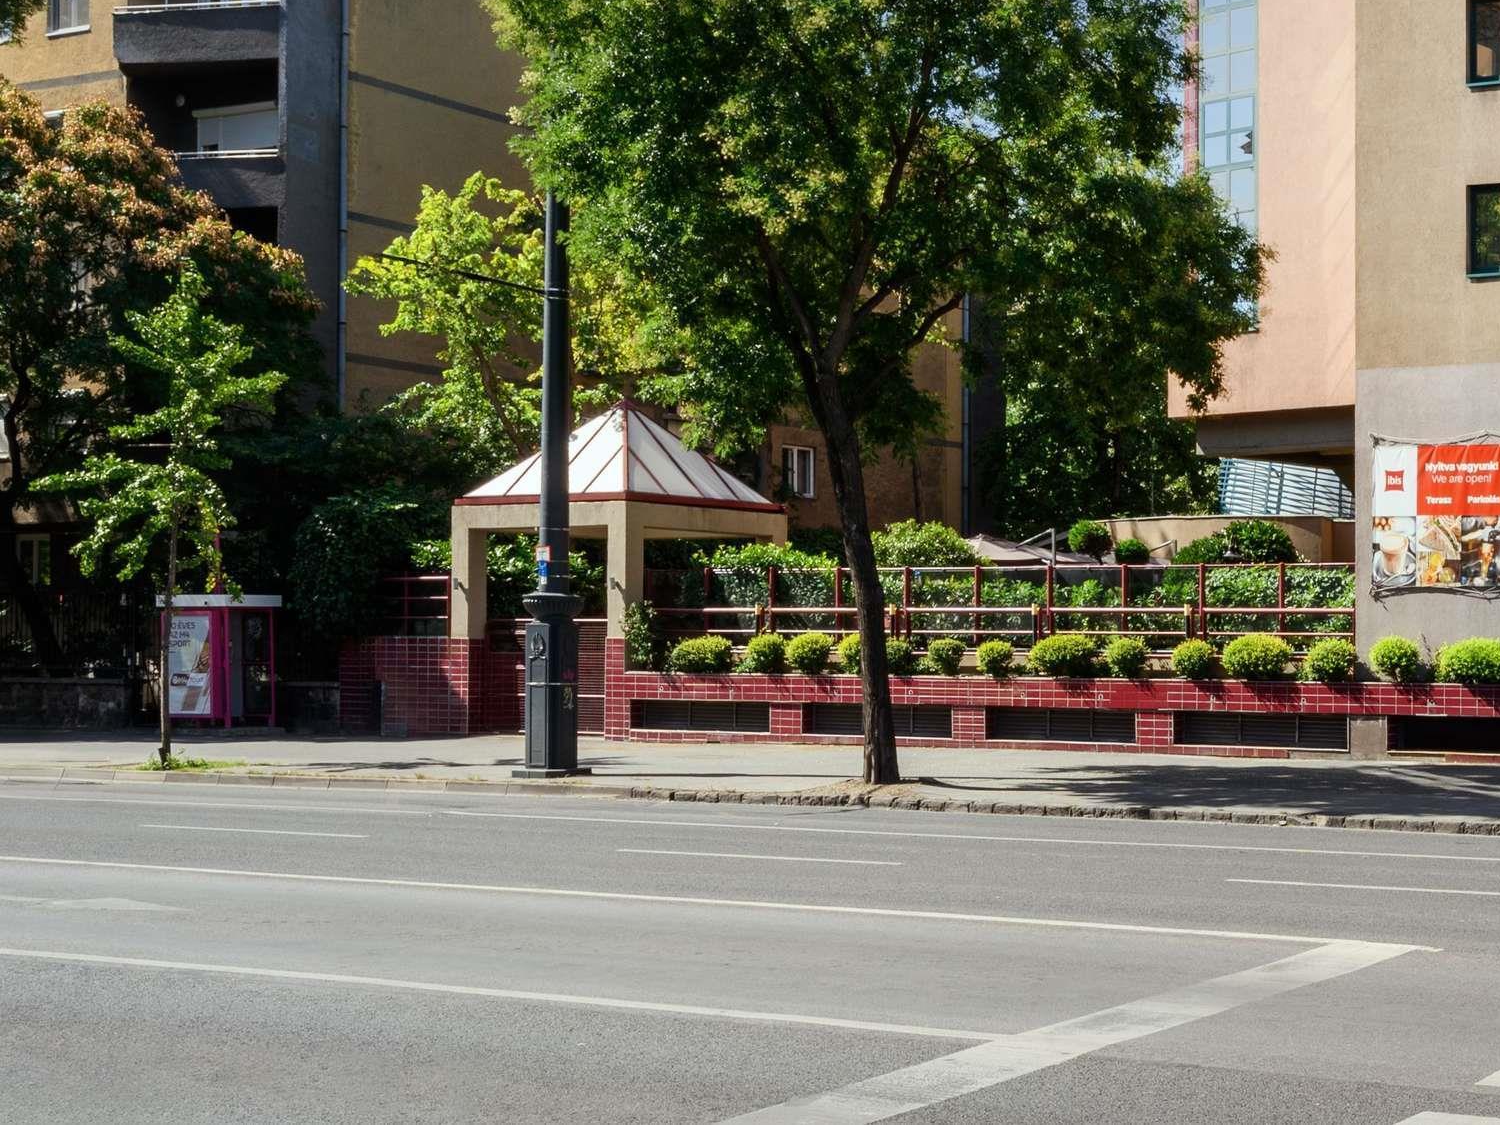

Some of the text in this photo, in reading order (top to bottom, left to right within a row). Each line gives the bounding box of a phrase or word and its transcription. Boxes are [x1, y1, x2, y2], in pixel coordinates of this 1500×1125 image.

[1425, 461, 1456, 473] Nyitva
[1387, 474, 1402, 485] ibis
[1431, 475, 1447, 483] We
[1465, 474, 1492, 485] open!
